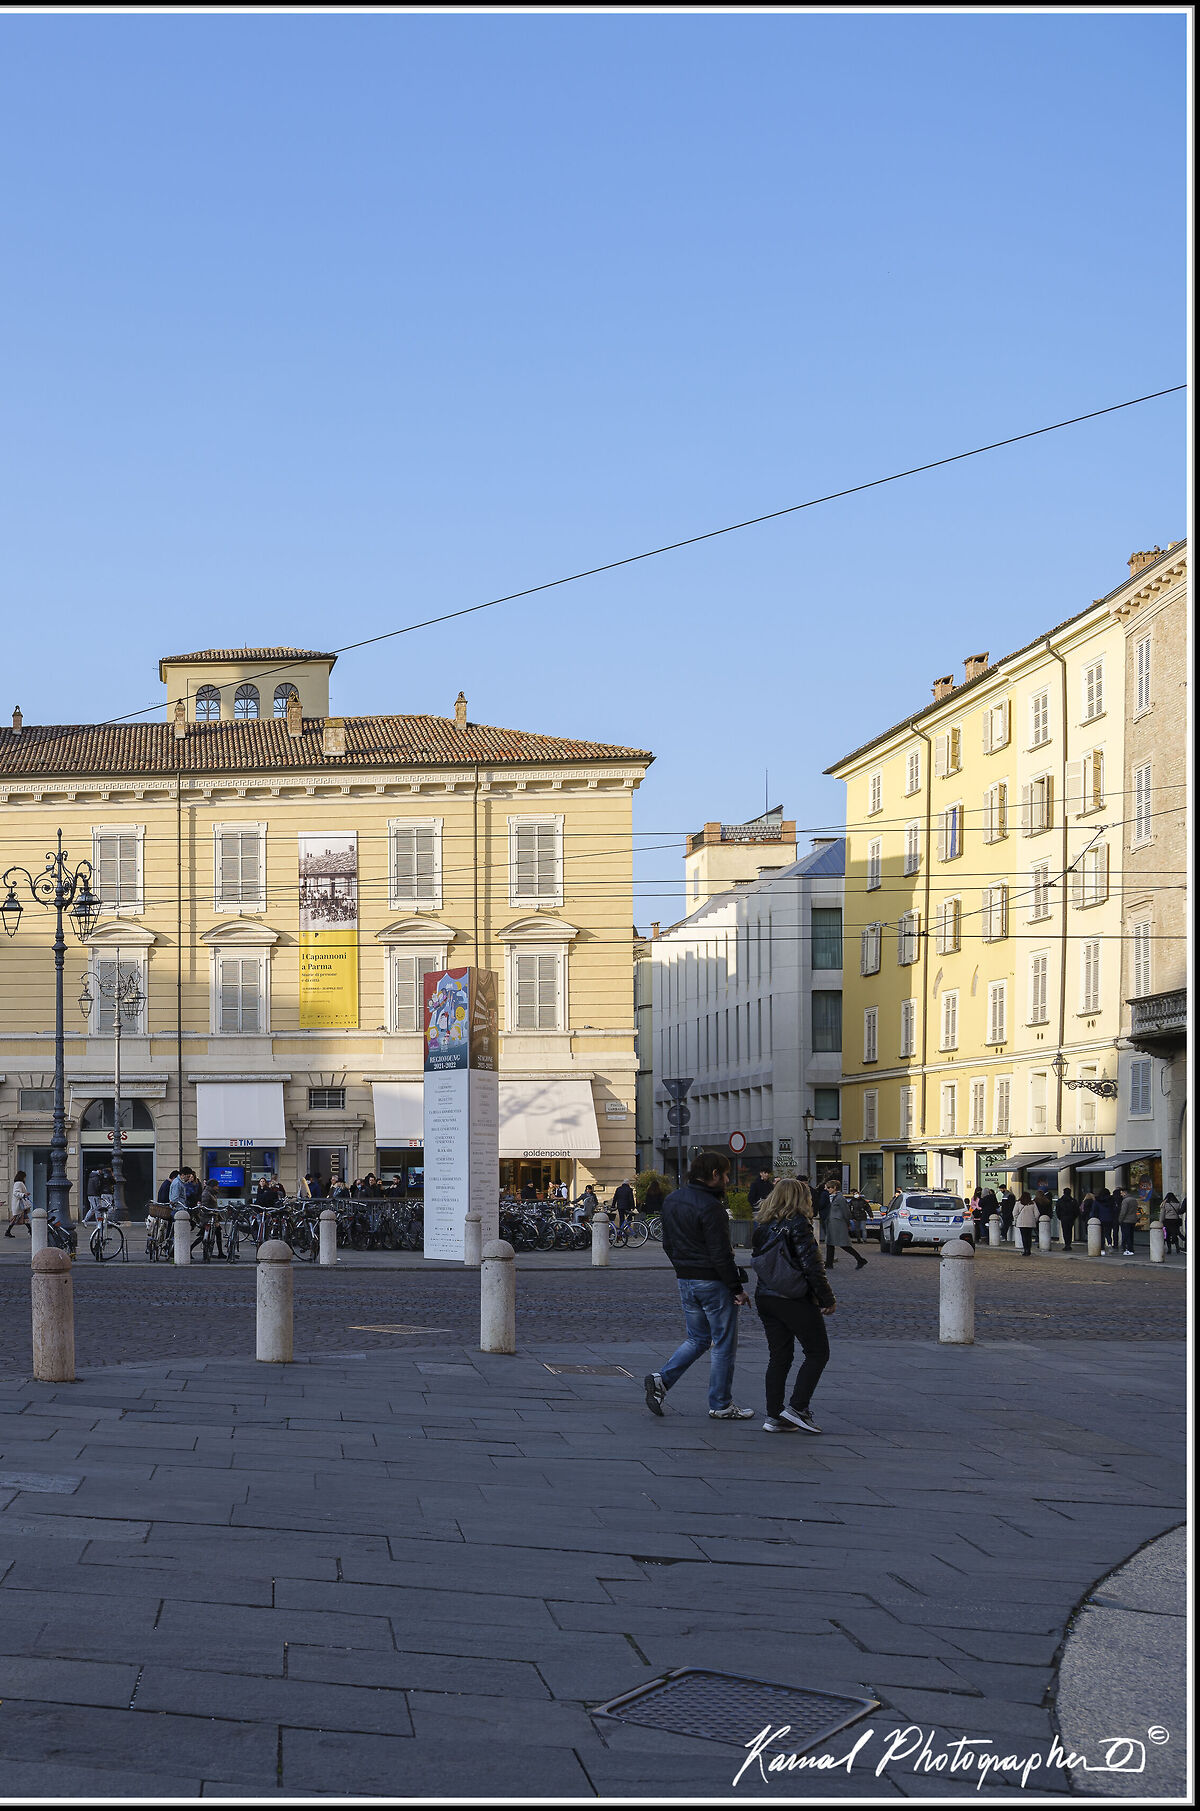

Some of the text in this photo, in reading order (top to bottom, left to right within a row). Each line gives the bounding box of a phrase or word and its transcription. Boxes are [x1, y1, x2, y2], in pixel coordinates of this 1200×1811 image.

[305, 952, 347, 961] Capannoni
[1071, 1136, 1103, 1152] PINALLI
[523, 1149, 571, 1158] goldenpoint
